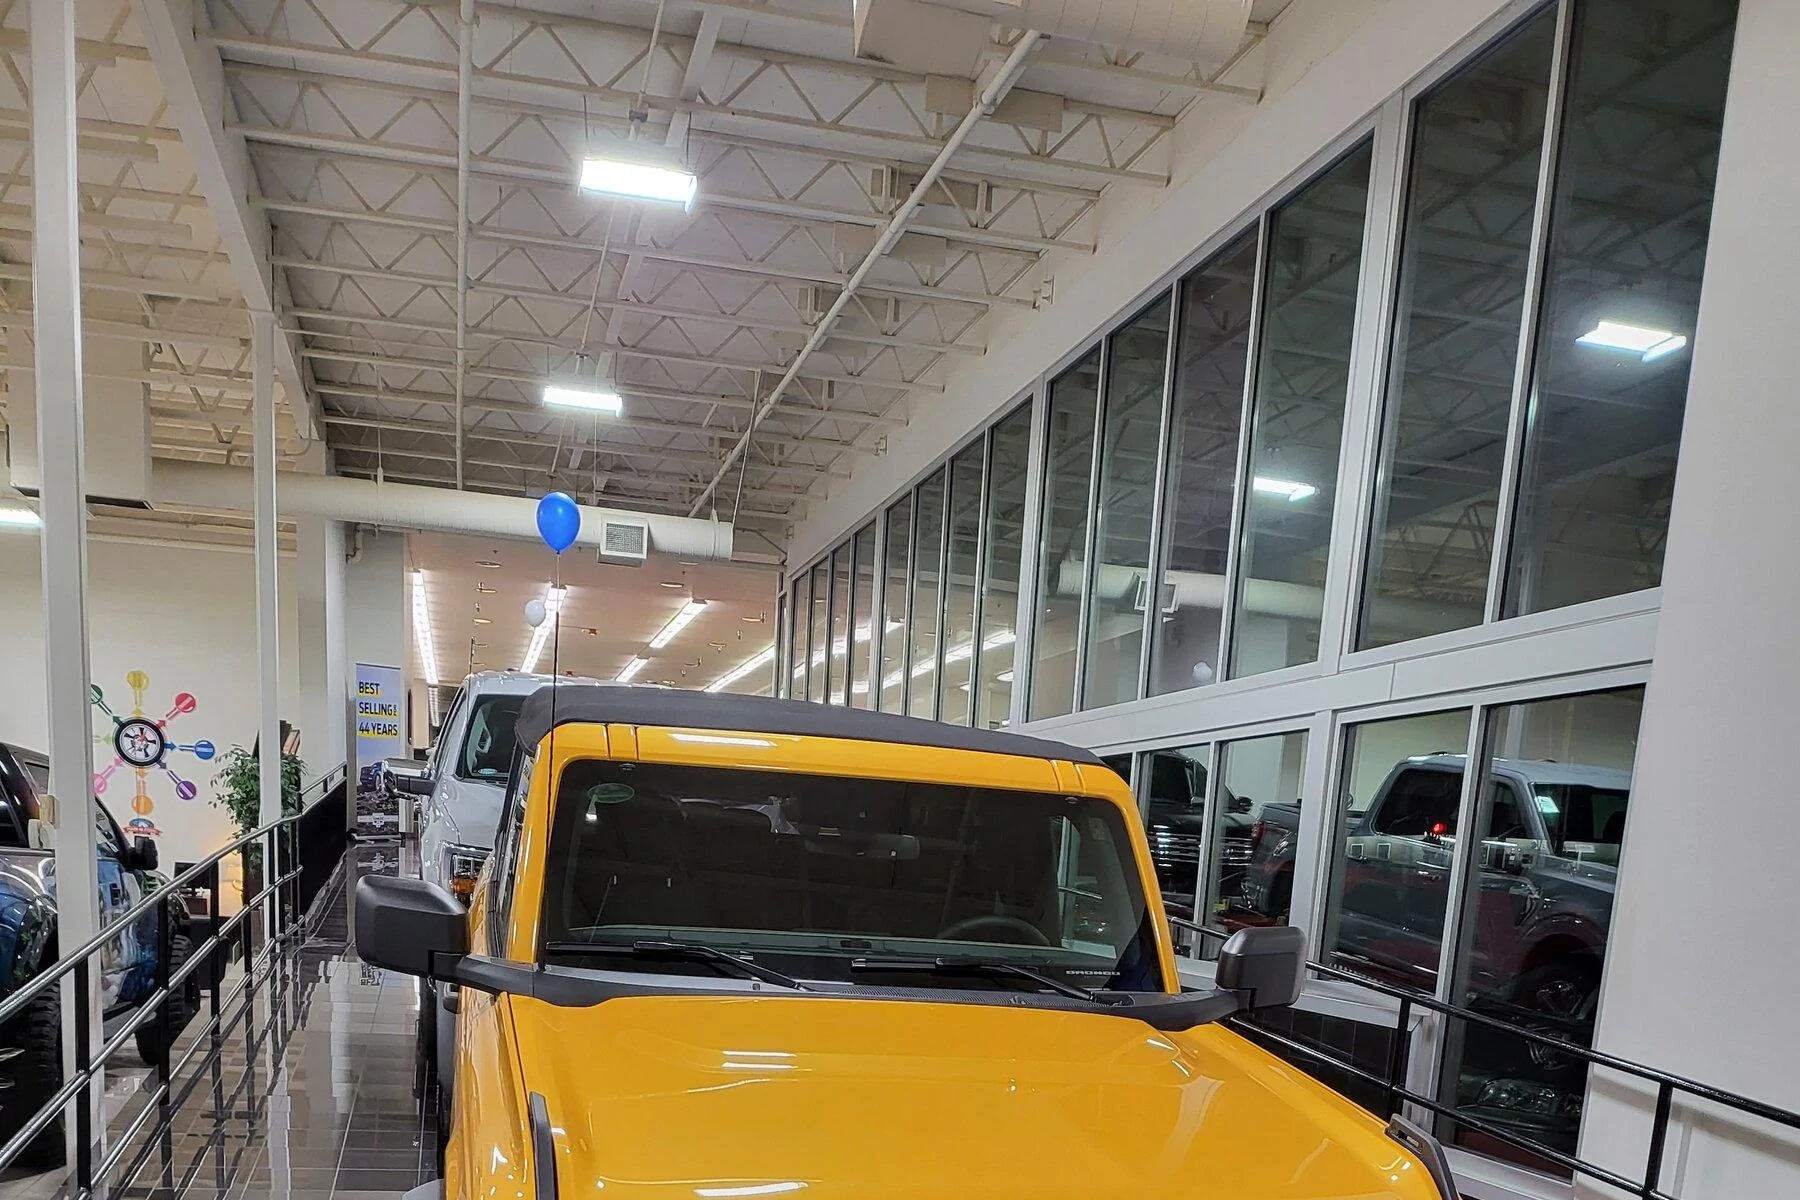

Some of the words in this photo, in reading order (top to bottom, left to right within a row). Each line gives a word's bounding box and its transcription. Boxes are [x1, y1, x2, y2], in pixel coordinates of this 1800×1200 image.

[359, 681, 380, 695] BEST
[359, 701, 393, 716] SELLING
[359, 721, 370, 734] 44
[371, 722, 398, 736] YEARS
